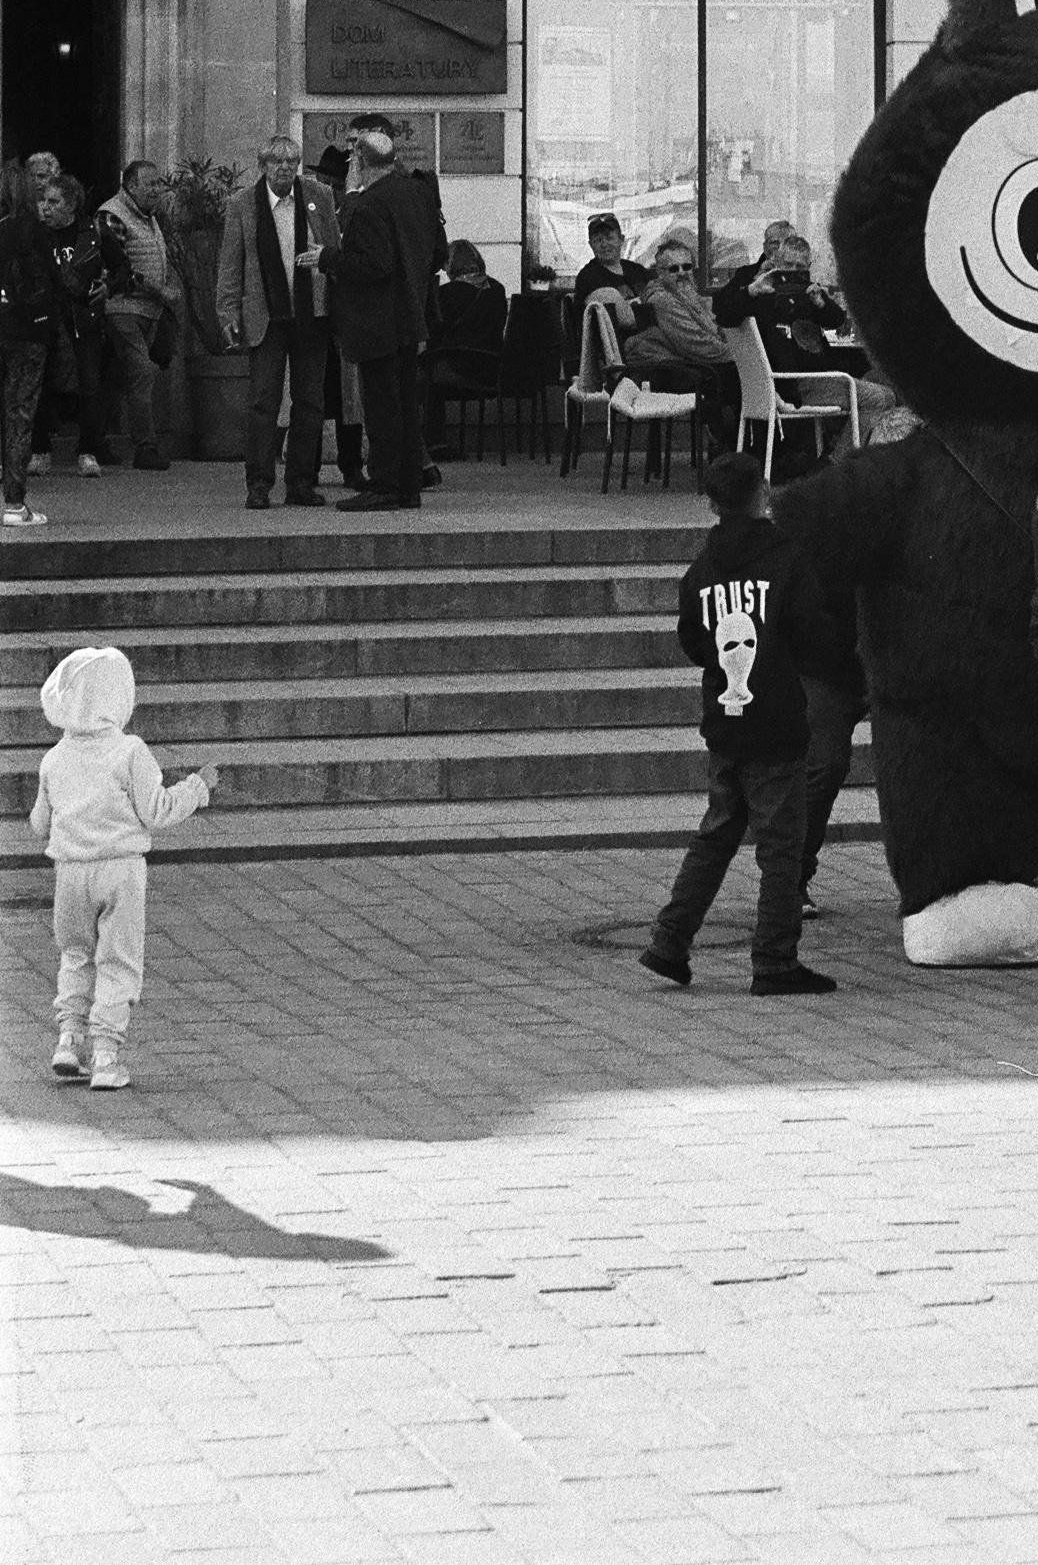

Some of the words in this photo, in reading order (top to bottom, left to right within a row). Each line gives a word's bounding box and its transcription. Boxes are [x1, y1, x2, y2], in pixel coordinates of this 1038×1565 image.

[331, 24, 385, 44] DOM
[331, 58, 480, 80] LITERATURY
[699, 579, 770, 631] TRUST
